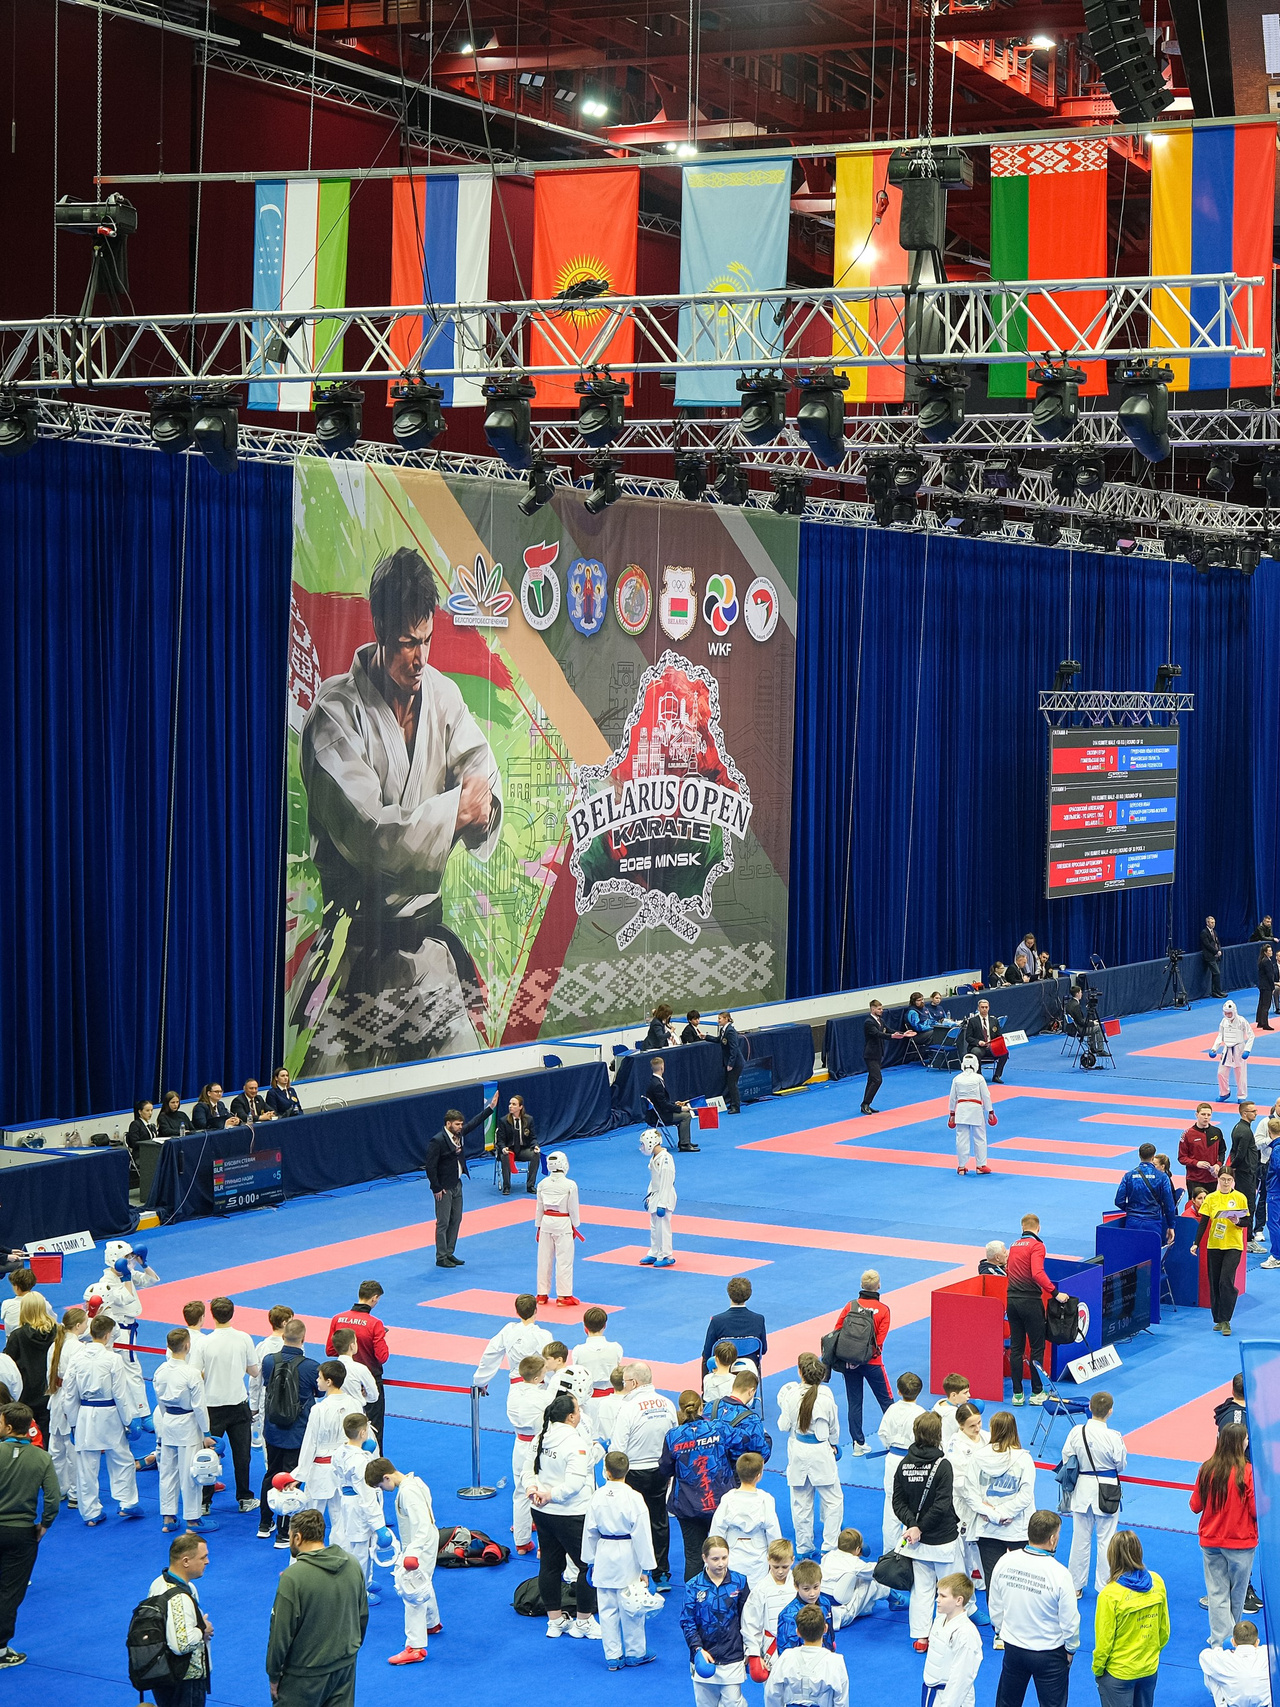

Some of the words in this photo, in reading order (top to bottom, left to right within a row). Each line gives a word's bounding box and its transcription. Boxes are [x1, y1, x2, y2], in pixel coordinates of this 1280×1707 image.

[708, 642, 732, 656] WKF
[572, 780, 677, 843] BELARUS
[681, 783, 751, 834] OPEN
[612, 817, 711, 849] KARATE
[620, 858, 651, 872] 2026
[655, 853, 702, 869] MINSK
[276, 1152, 281, 1162] 0
[276, 1170, 281, 1180] 5
[80, 1237, 87, 1247] 2
[337, 1317, 367, 1326] BELARUS
[1108, 1353, 1115, 1364] 1
[638, 1399, 668, 1411] IPPON
[673, 1440, 696, 1452] STAR
[696, 1434, 720, 1446] TEAM
[693, 1455, 718, 1511] 空手道
